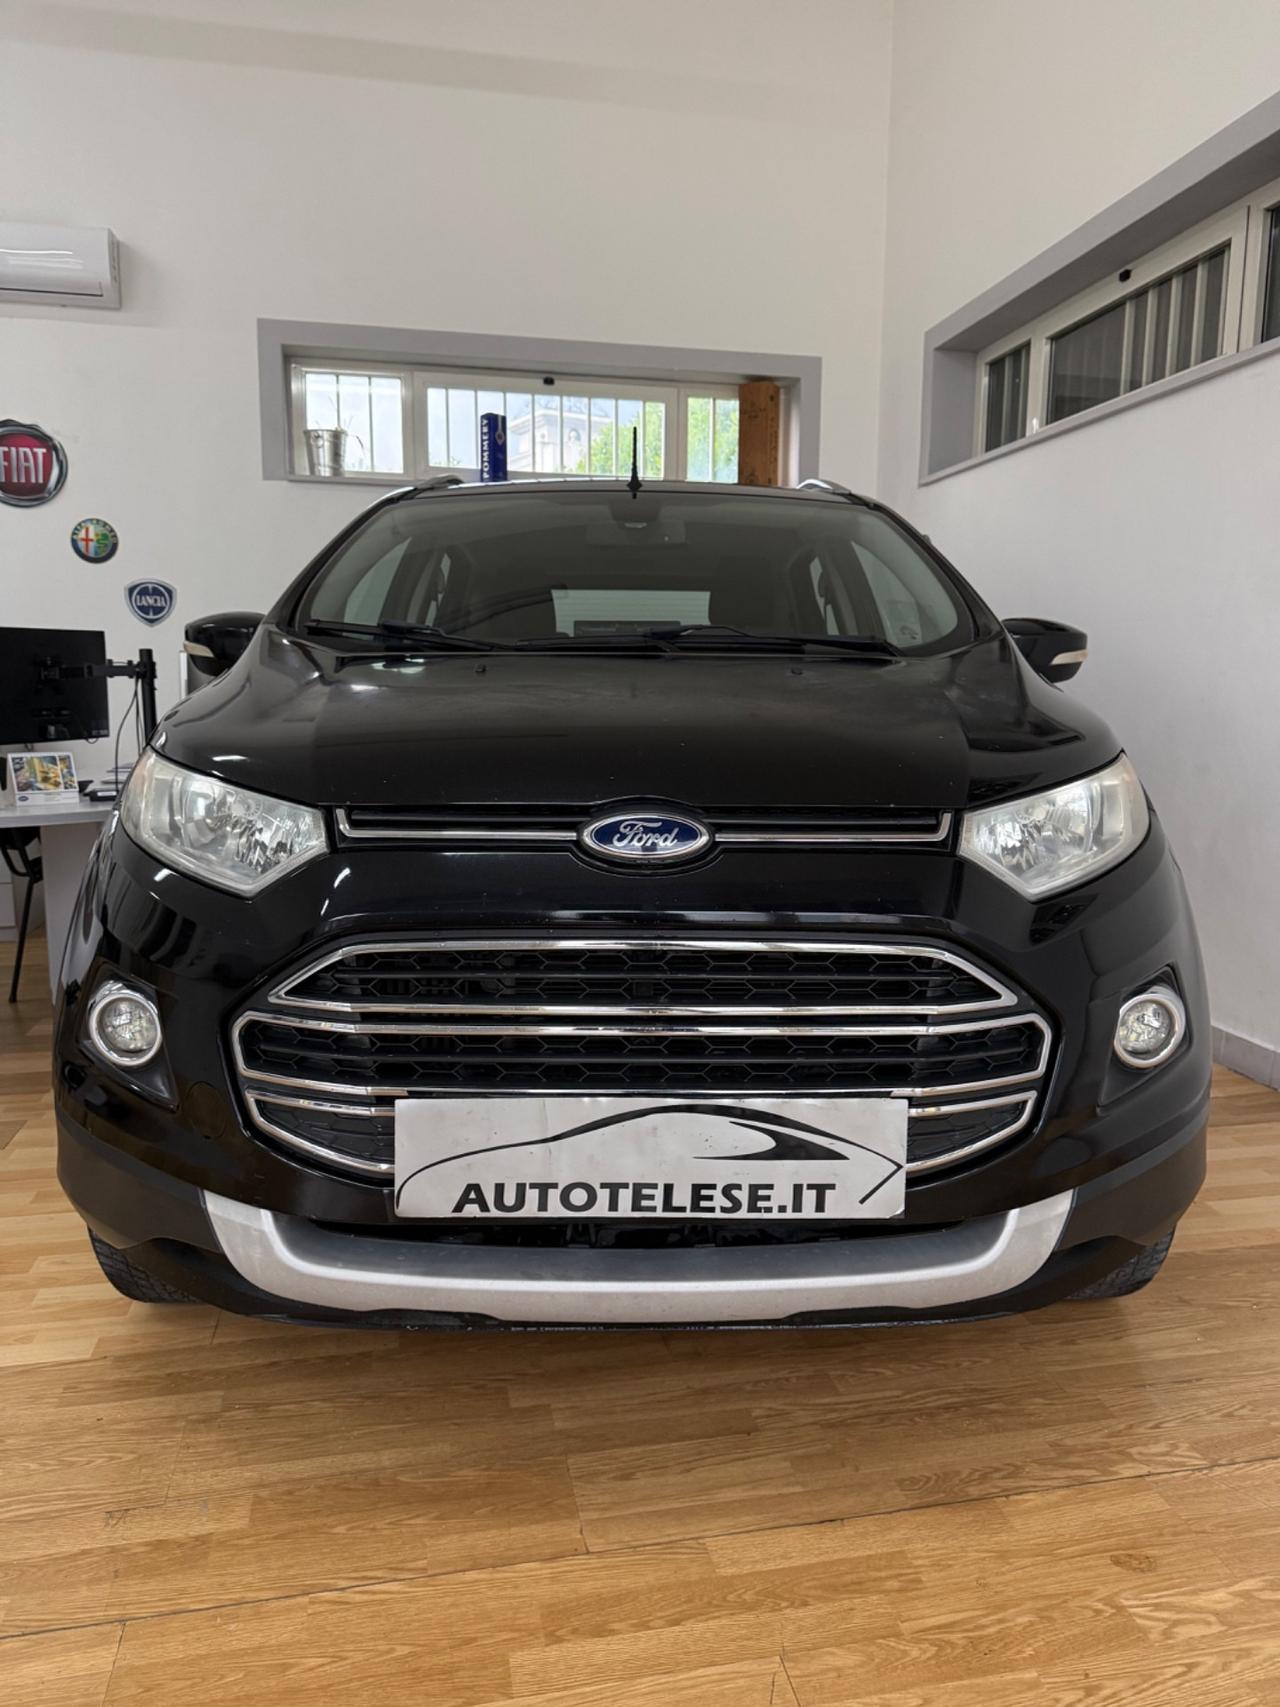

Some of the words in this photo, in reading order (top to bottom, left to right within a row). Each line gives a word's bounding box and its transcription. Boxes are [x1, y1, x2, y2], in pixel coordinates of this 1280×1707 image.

[0, 446, 47, 483] FIAT
[136, 595, 166, 607] LANCIA
[612, 821, 679, 847] Ford
[452, 1182, 836, 1213] AUTOTELESE.IT
